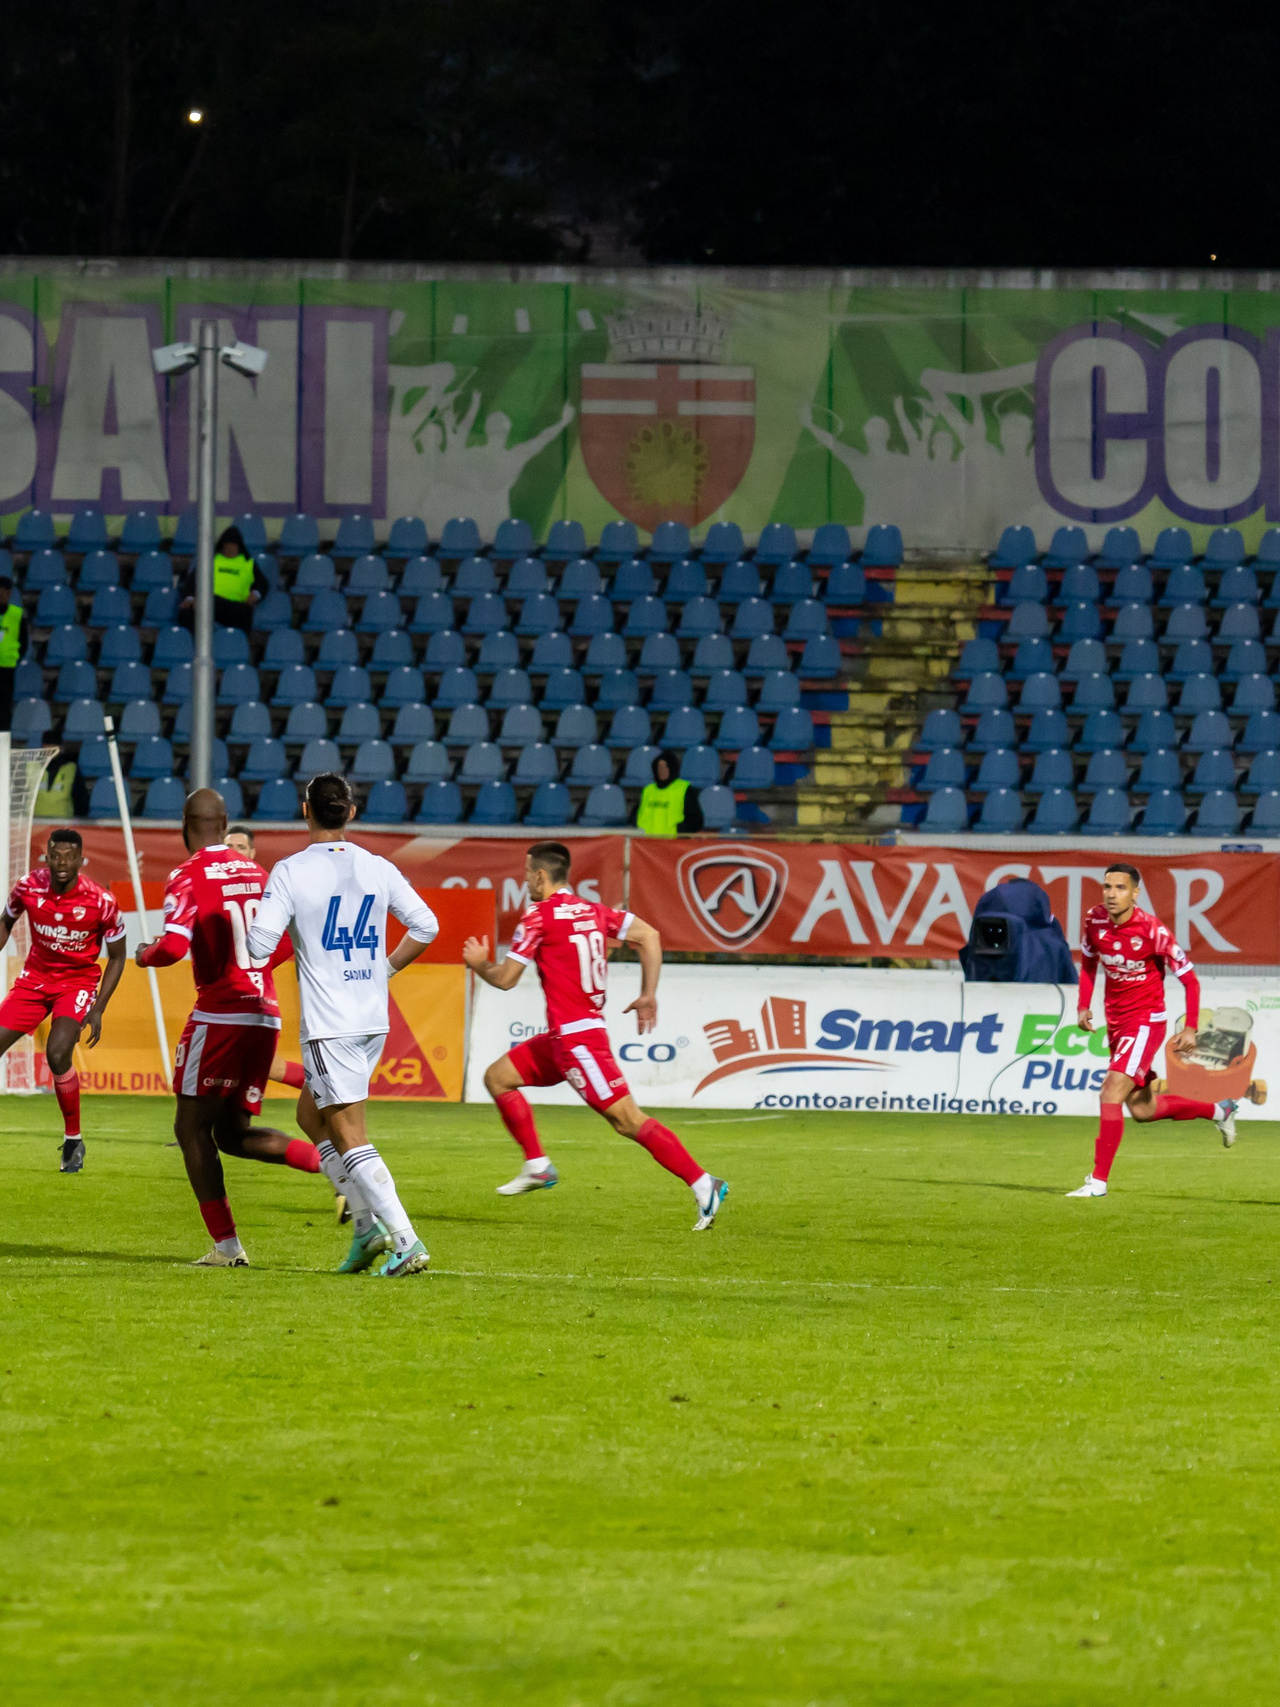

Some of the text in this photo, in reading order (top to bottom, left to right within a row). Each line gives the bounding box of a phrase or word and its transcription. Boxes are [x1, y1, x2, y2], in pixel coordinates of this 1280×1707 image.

[321, 894, 379, 961] 44
[791, 859, 1241, 953] AVATR
[568, 930, 606, 994] 18
[75, 989, 89, 1007] 8
[815, 1008, 1004, 1055] Smart
[1022, 1058, 1108, 1092] Plus
[763, 1089, 1059, 1115] contoareinteligente.ro
